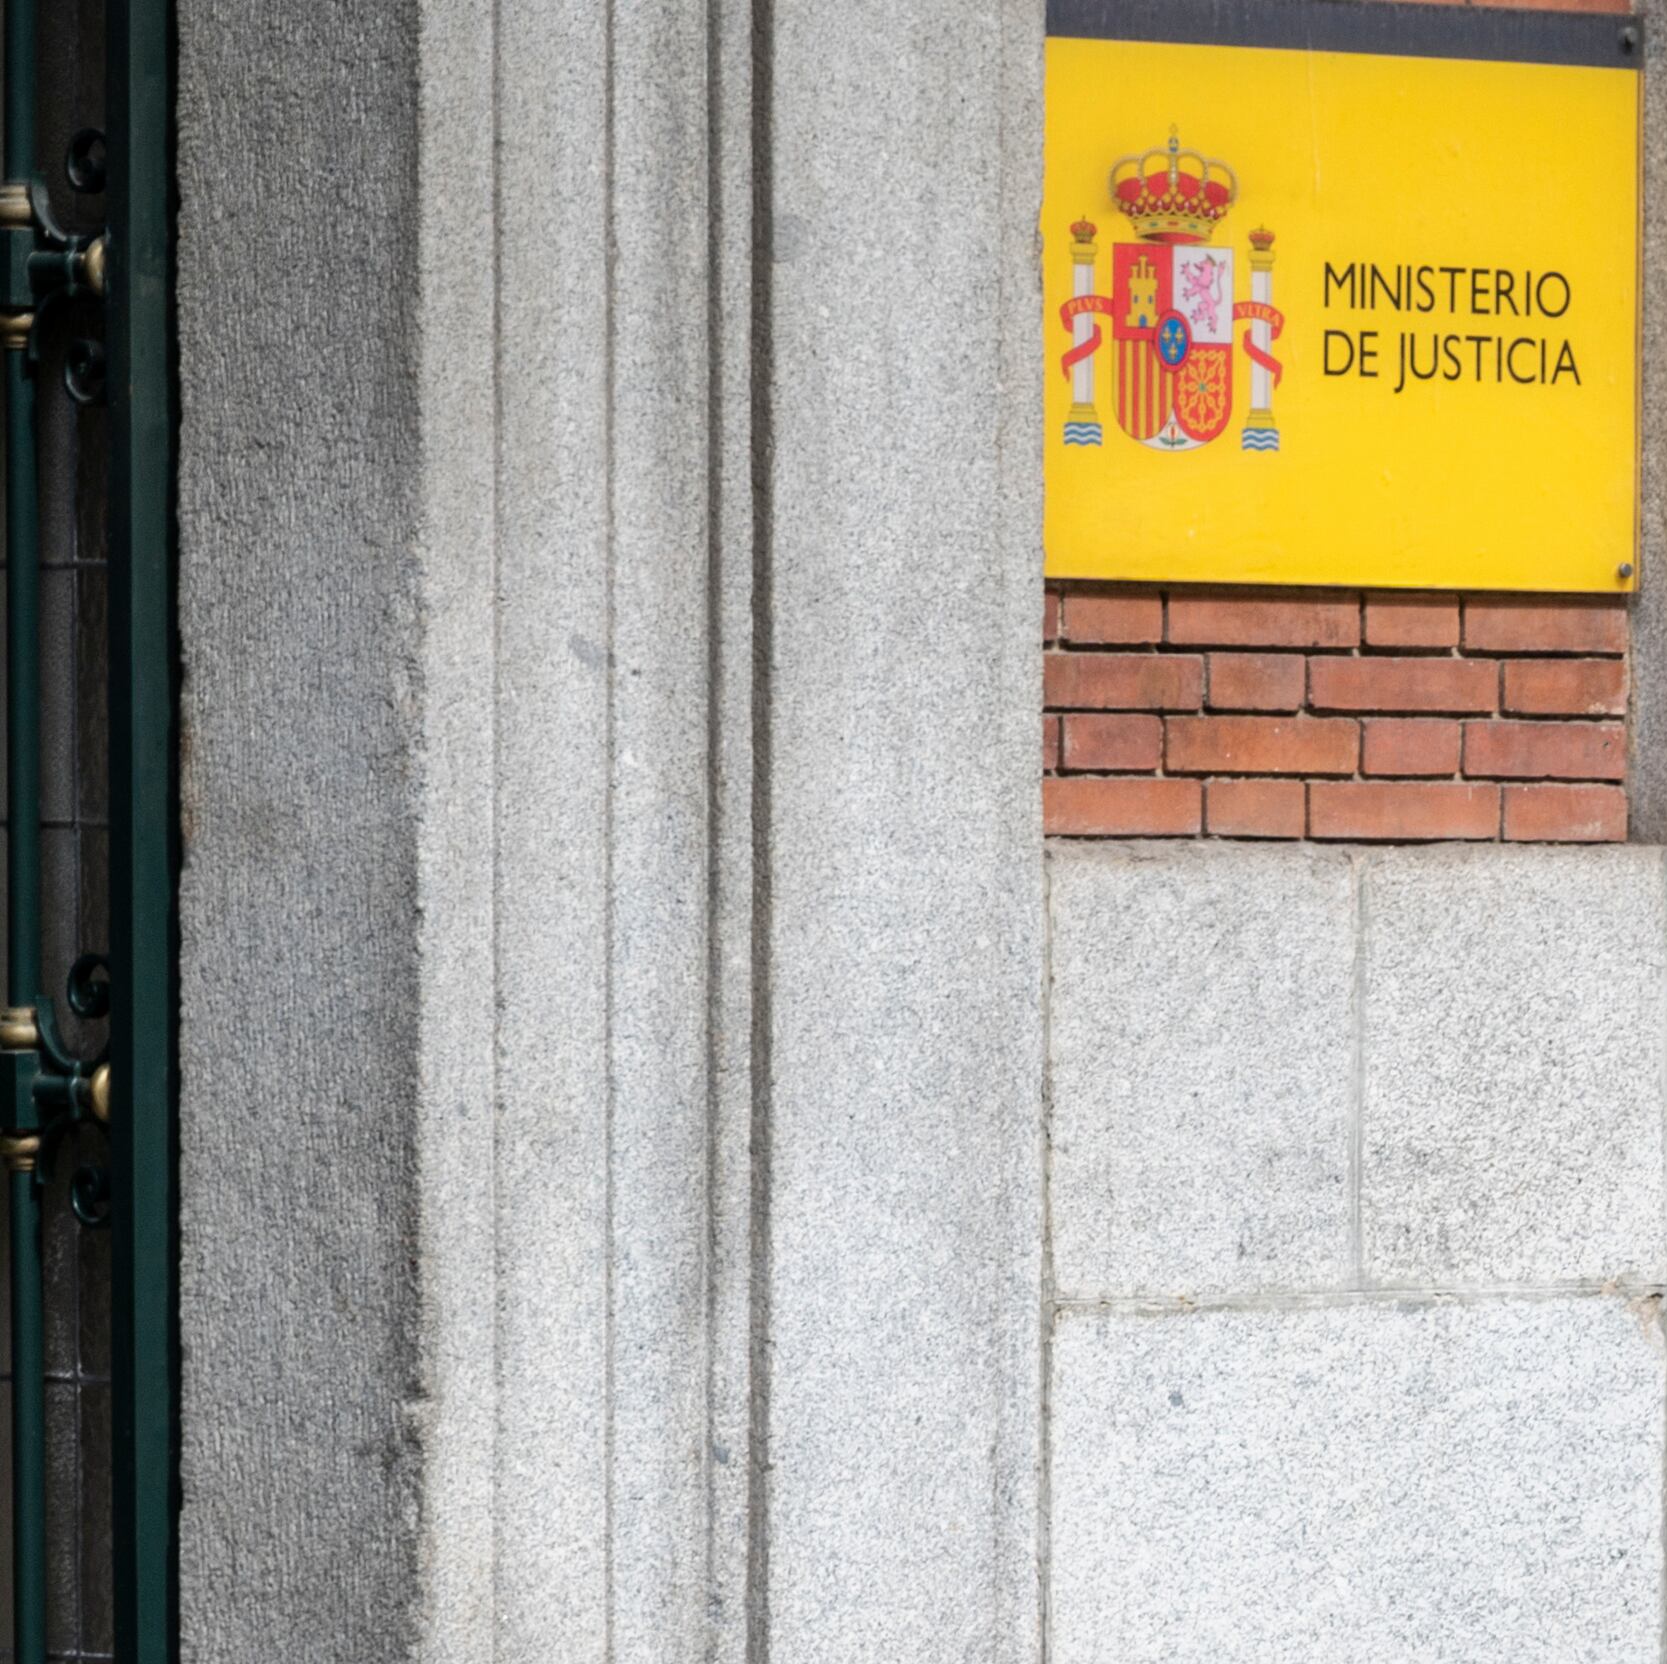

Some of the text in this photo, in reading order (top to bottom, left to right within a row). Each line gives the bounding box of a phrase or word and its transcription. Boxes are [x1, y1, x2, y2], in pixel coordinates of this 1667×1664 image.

[1067, 297, 1104, 315] PLVS
[1324, 261, 1571, 318] MINISTERIO
[1323, 329, 1581, 393] DE JUSTICIA
